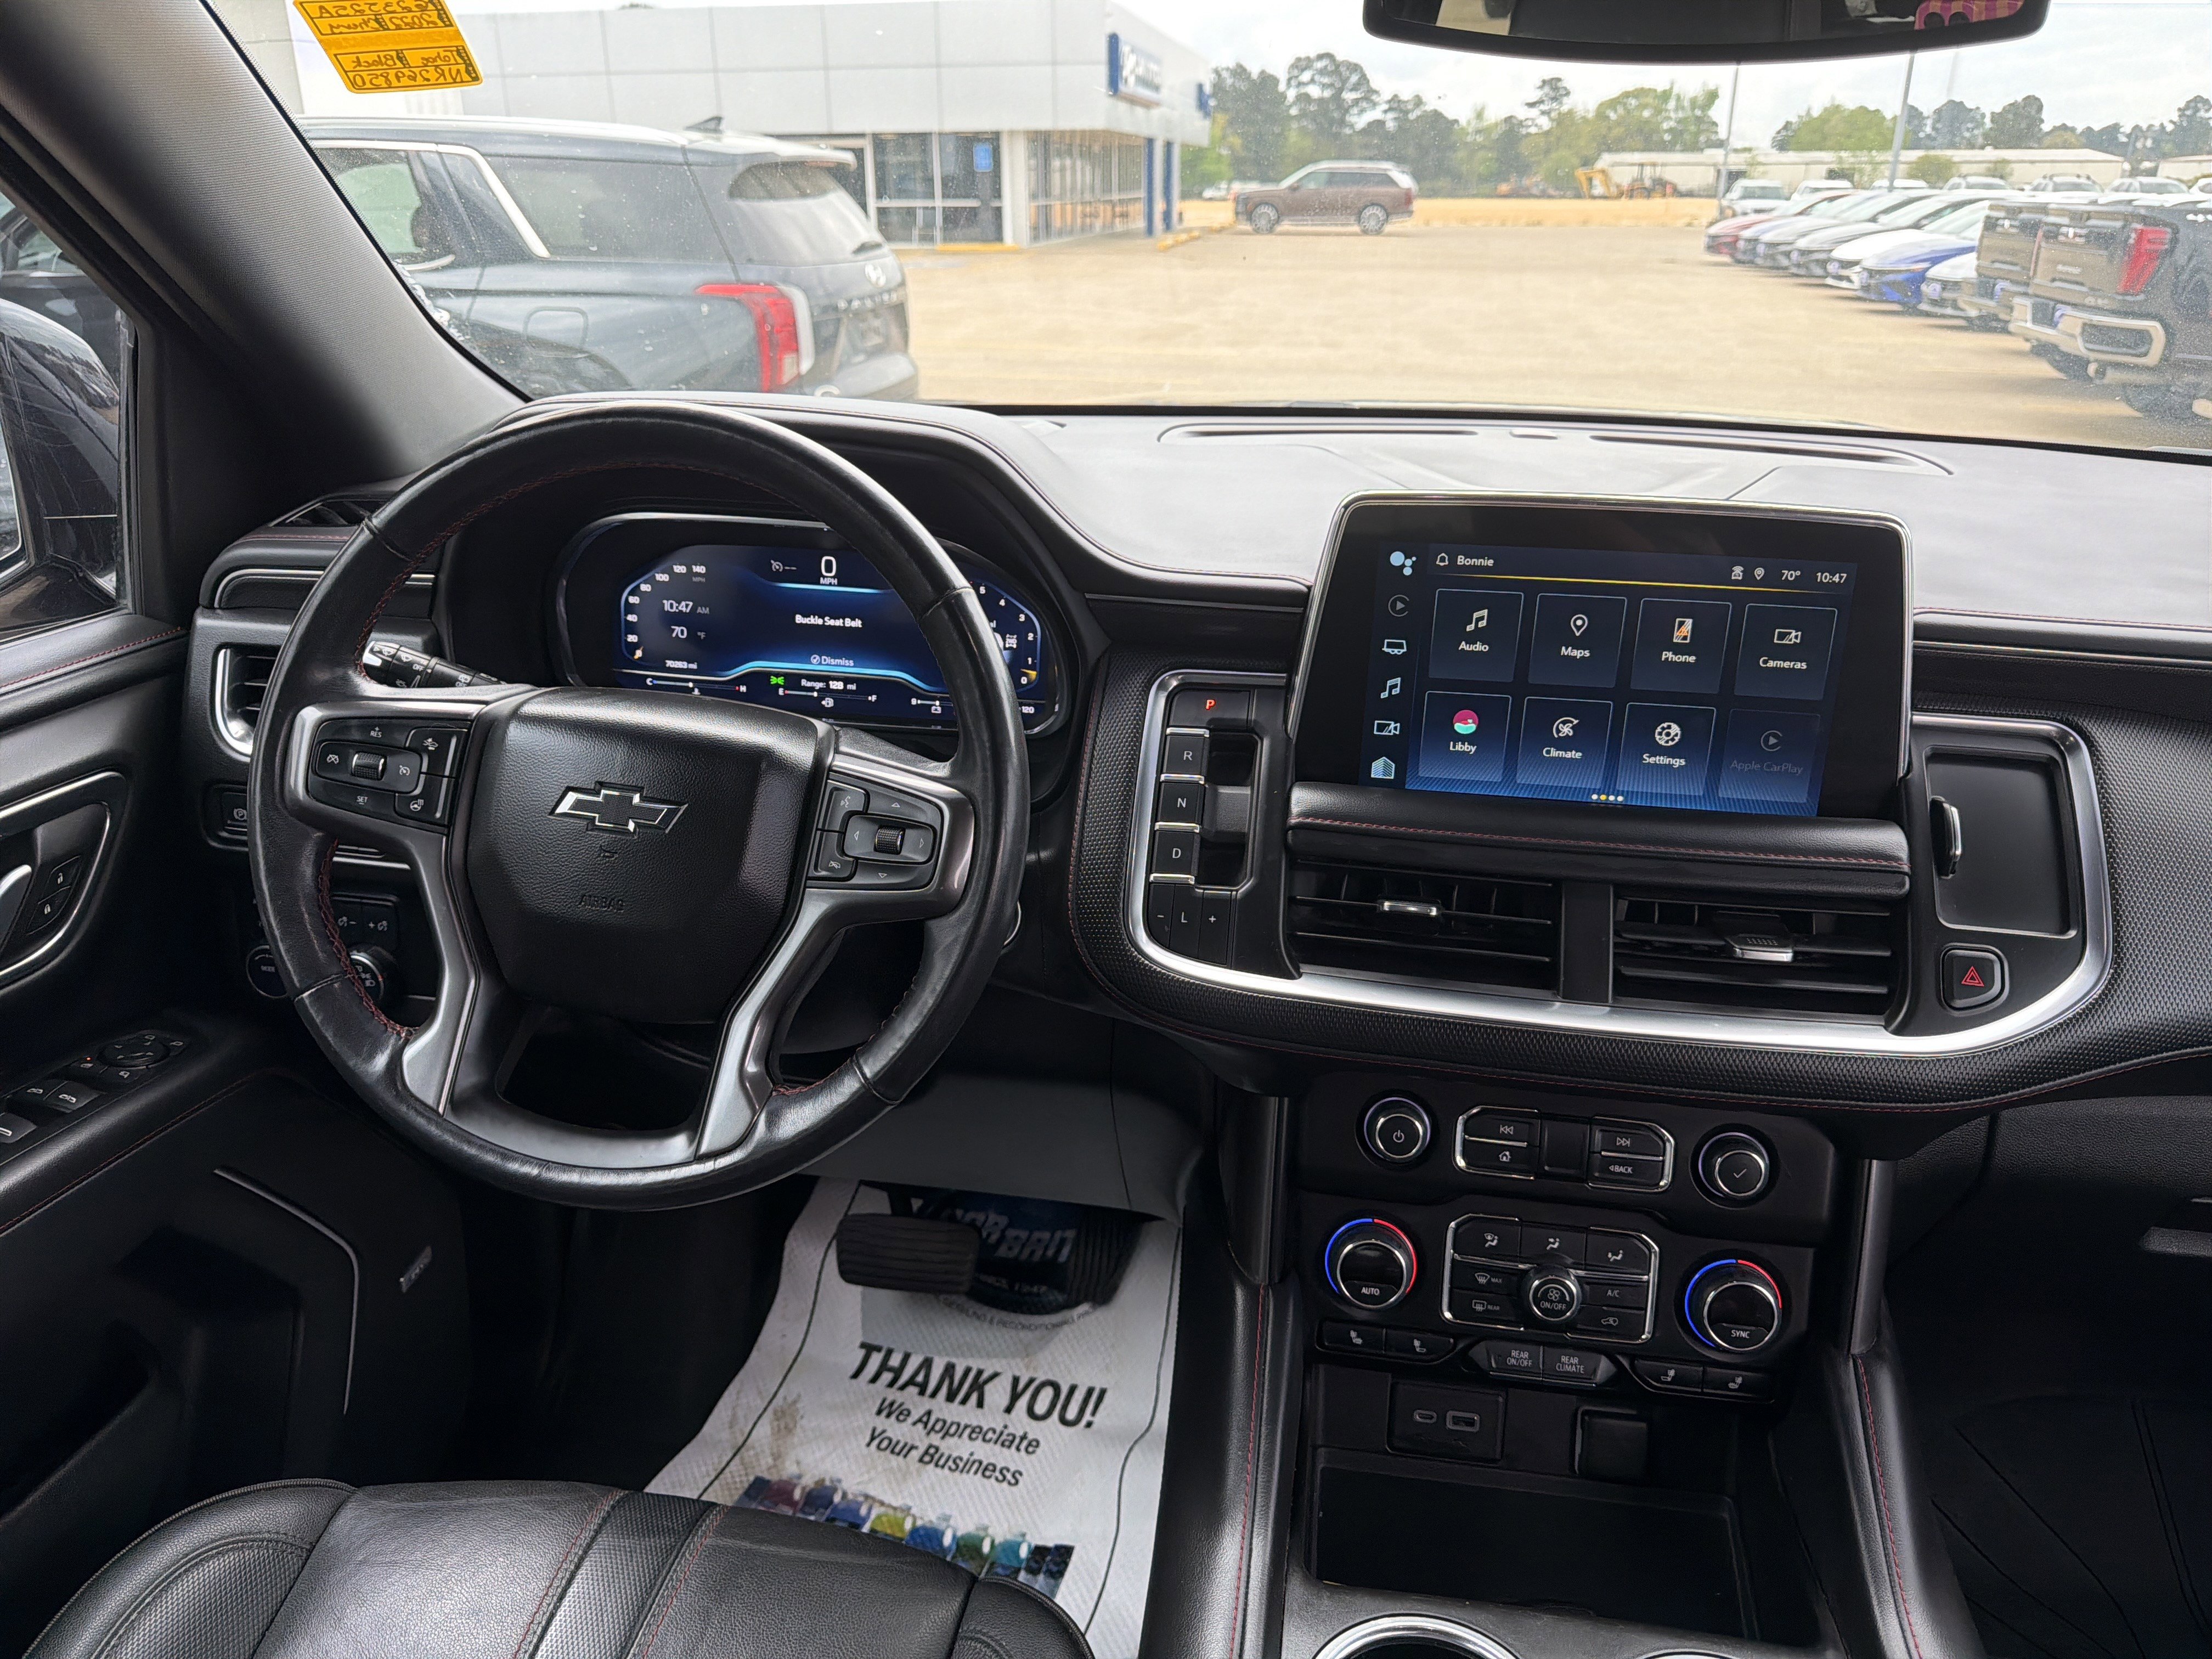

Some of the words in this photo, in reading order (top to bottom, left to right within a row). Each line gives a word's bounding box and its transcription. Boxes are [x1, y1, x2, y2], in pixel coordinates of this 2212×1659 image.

[821, 556, 837, 577] 0
[1457, 556, 1494, 567] Bonnie
[673, 565, 686, 573] 120
[692, 565, 706, 574] 140
[655, 573, 669, 582] 100
[820, 577, 838, 585] MPH
[1781, 570, 1801, 581] 70°
[1815, 572, 1847, 584] 10:47
[640, 584, 651, 592] 80
[663, 600, 693, 613] 10:47
[999, 599, 1006, 607] 4
[626, 614, 638, 622] 40
[795, 614, 823, 625] Buckle
[824, 617, 843, 627] Seat
[845, 618, 863, 628] Belt
[1019, 614, 1025, 622] 3
[671, 625, 687, 639] 70
[1458, 641, 1489, 652] Audio
[1561, 646, 1590, 658] Maps
[1661, 651, 1696, 663] Phone
[821, 656, 854, 667] Dismiss
[1027, 657, 1031, 665] 1
[1759, 657, 1807, 669] Cameras
[801, 679, 826, 690] Range:
[828, 680, 844, 690] 128
[1205, 699, 1216, 710] P
[1449, 741, 1477, 754] Libby
[1183, 751, 1192, 760] R
[1543, 747, 1582, 759] Climate
[1643, 753, 1686, 768] Settings
[1730, 759, 1760, 773] Apple
[1763, 761, 1803, 776] CarPlay
[1177, 798, 1186, 808] N
[1172, 848, 1181, 858] D
[1181, 912, 1188, 923] L
[1614, 1165, 1633, 1174] BACK
[1361, 1286, 1380, 1296] AUTO
[1606, 1289, 1620, 1298] A/C
[1540, 1301, 1567, 1311] ON/OFF
[1731, 1329, 1750, 1339] SYNC
[1511, 1350, 1529, 1359] REAR
[1506, 1357, 1533, 1367] ON/OFF
[1561, 1355, 1579, 1365] REAR
[1556, 1363, 1584, 1373] CLIMATE
[850, 1341, 1002, 1409] THANK
[1003, 1375, 1107, 1429] YOU!
[875, 1396, 912, 1423] We
[912, 1409, 1041, 1455] Appreciate
[866, 1426, 919, 1459] Your
[918, 1443, 1024, 1487] Business
